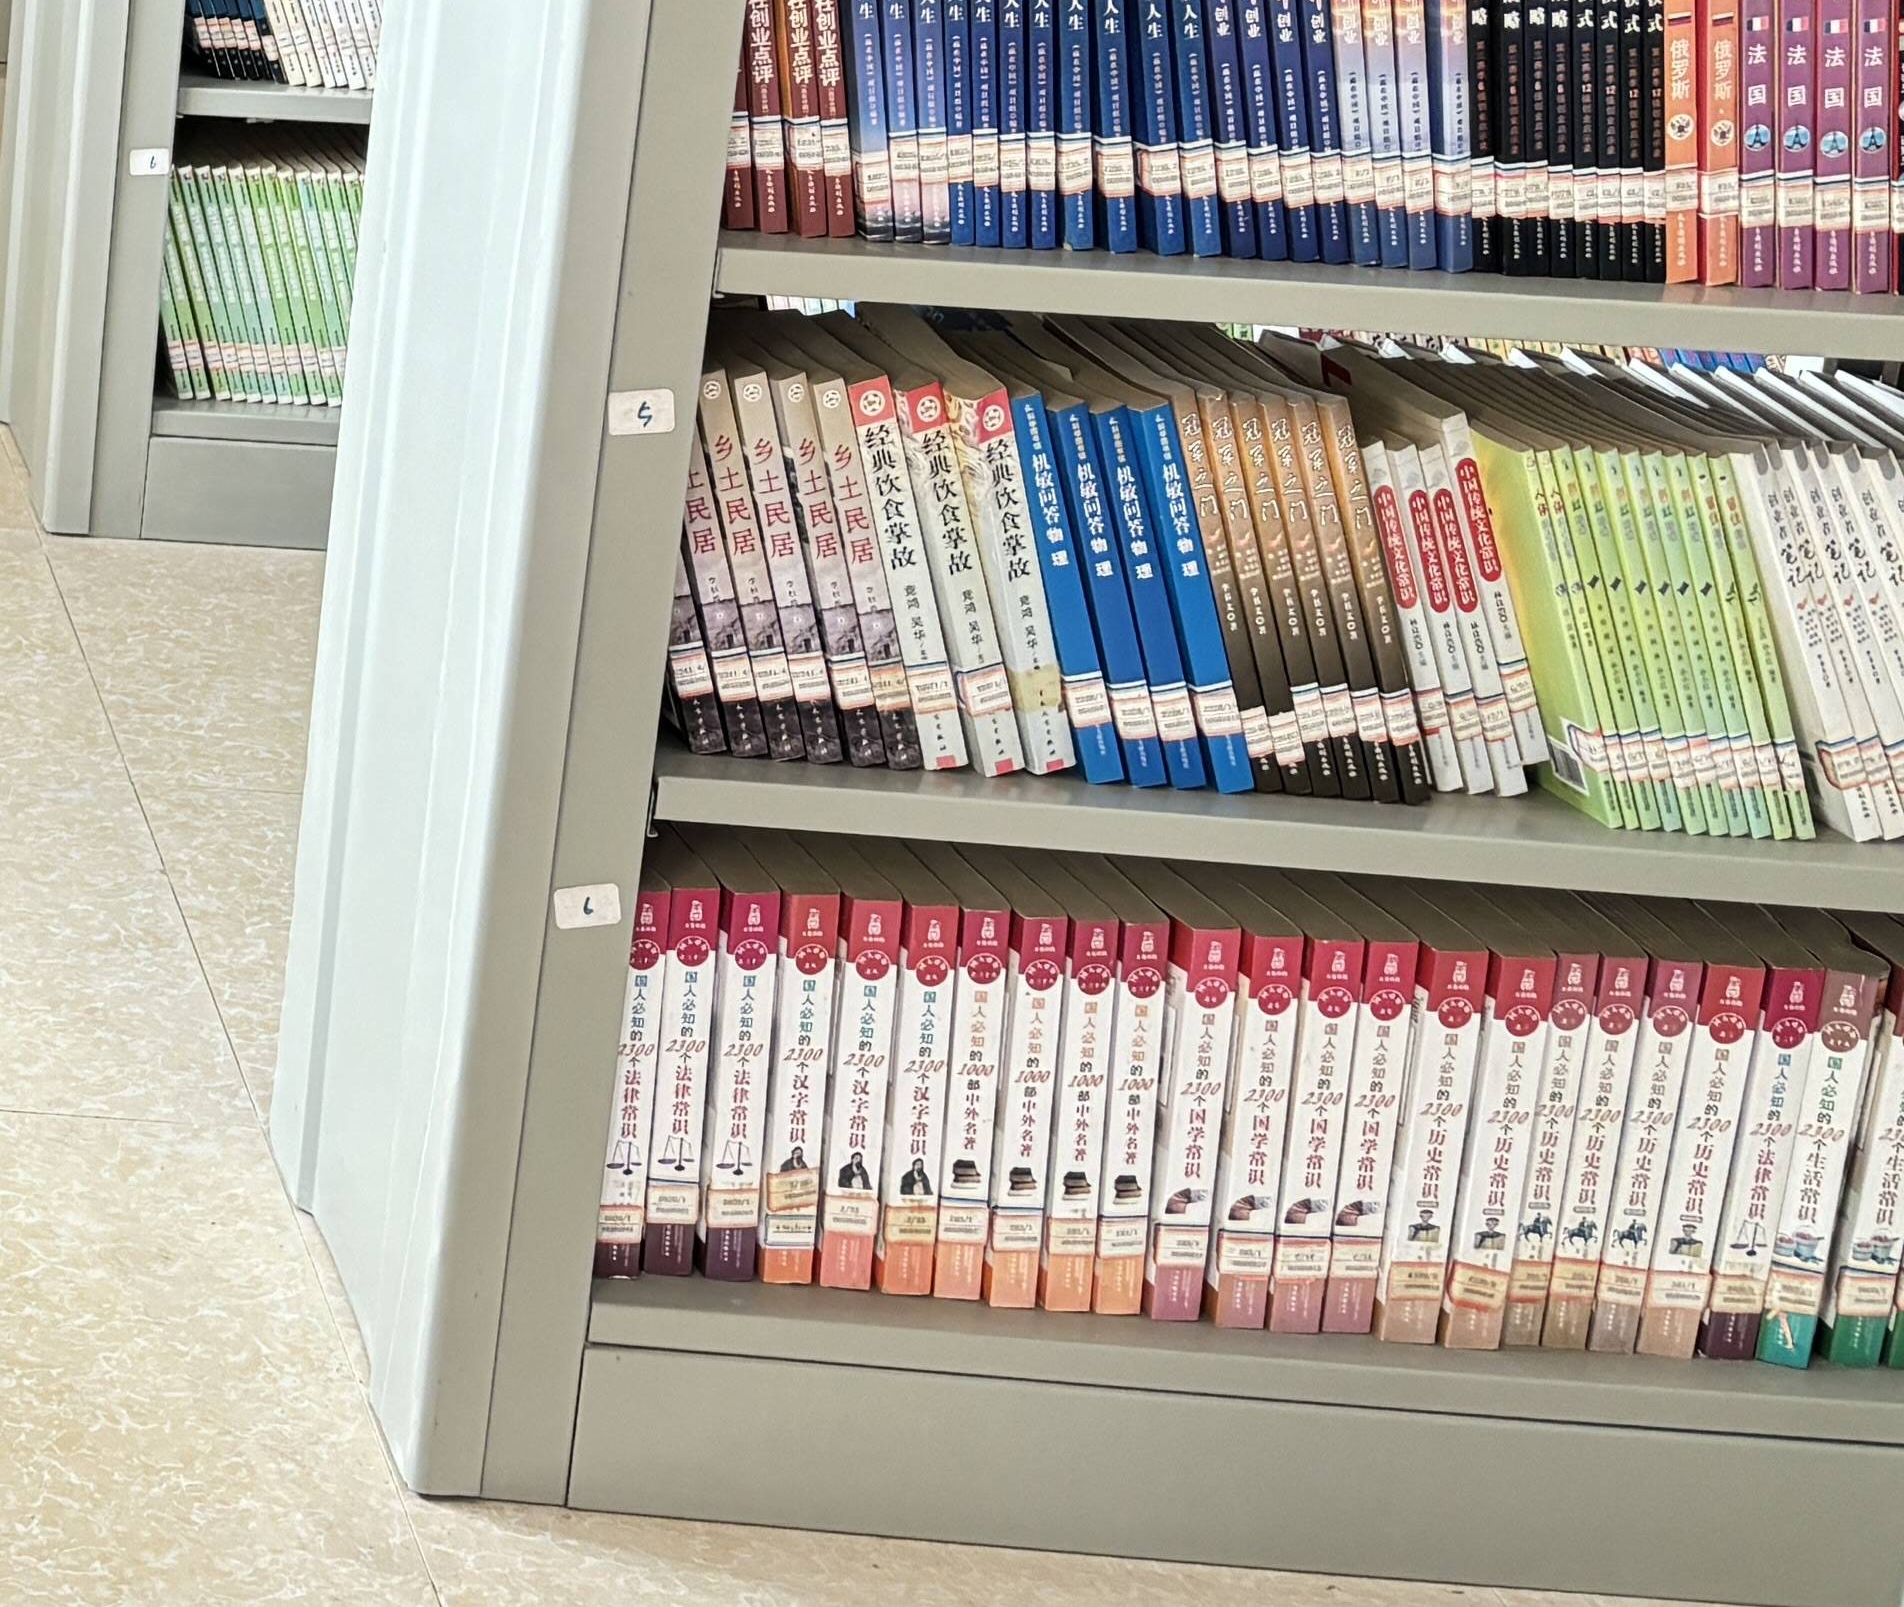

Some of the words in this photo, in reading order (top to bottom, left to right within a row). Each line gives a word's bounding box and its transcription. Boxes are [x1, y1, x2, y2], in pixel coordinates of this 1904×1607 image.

[1669, 38, 1691, 100] 俄罗斯
[1713, 38, 1734, 100] 俄罗斯
[1747, 42, 1768, 107] 法国
[1787, 43, 1808, 107] 法国
[1824, 45, 1846, 109] 法国
[1863, 43, 1884, 108] 法国
[636, 400, 653, 427] 5
[714, 433, 757, 557] 乡土民居
[752, 436, 795, 559] 乡土民居
[797, 436, 839, 561] 乡土民居
[833, 442, 875, 566] 乡土民居
[864, 423, 918, 571] 经典饮食掌故
[920, 429, 974, 577] 经典饮食掌故
[985, 436, 1032, 583] 经典饮食掌故
[1031, 452, 1070, 567] 机敏问答物理
[1077, 461, 1115, 578] 机敏问答物理
[1116, 464, 1155, 580] 机敏问答物理
[1161, 461, 1201, 578] 机敏问答物理
[583, 896, 594, 916] 6
[617, 973, 655, 1140] 国人必知的2300个法律常识
[664, 970, 706, 1136] 国人必知的2300个法律常识
[723, 973, 764, 1140] 国人必知的2300个法律常识
[783, 978, 824, 1145] 国人必知的2300个汉字常识
[842, 984, 885, 1151] 国人必知的2300个汉字常识
[902, 990, 946, 1158] 国人必知的2300个汉字常识
[956, 990, 995, 1152] 国人必知的1000部中外名著
[1013, 996, 1051, 1158] 国人必知的1000部中外名著
[1067, 1000, 1104, 1163] 国人必知的1000部中外名著
[1117, 1003, 1155, 1166] 国人必知的1000部中外名著
[1179, 1013, 1222, 1180] 国人必知的2300个国学常识
[1242, 1019, 1286, 1186] 国人必知的2300个国学常识
[1300, 1022, 1344, 1190] 国人必知的2300个国学常识
[1353, 1025, 1397, 1192] 国人必知的2300个国学常识
[1418, 1032, 1464, 1202] 国人必知的2300个历史常识
[1486, 1041, 1531, 1209] 国人必知的2300个历史常识
[1533, 1034, 1575, 1202] 国人必知的2300个历史常识
[1577, 1039, 1622, 1206] 国人必知的2300个历史常识
[1629, 1041, 1675, 1209] 国人必知的2300个历史常识
[1685, 1048, 1733, 1217] 国人必知的2300个历史常识
[1748, 1053, 1793, 1222] 国人必知的2300个法律常识
[1797, 1056, 1846, 1224] 国人必知的2300个生活常识
